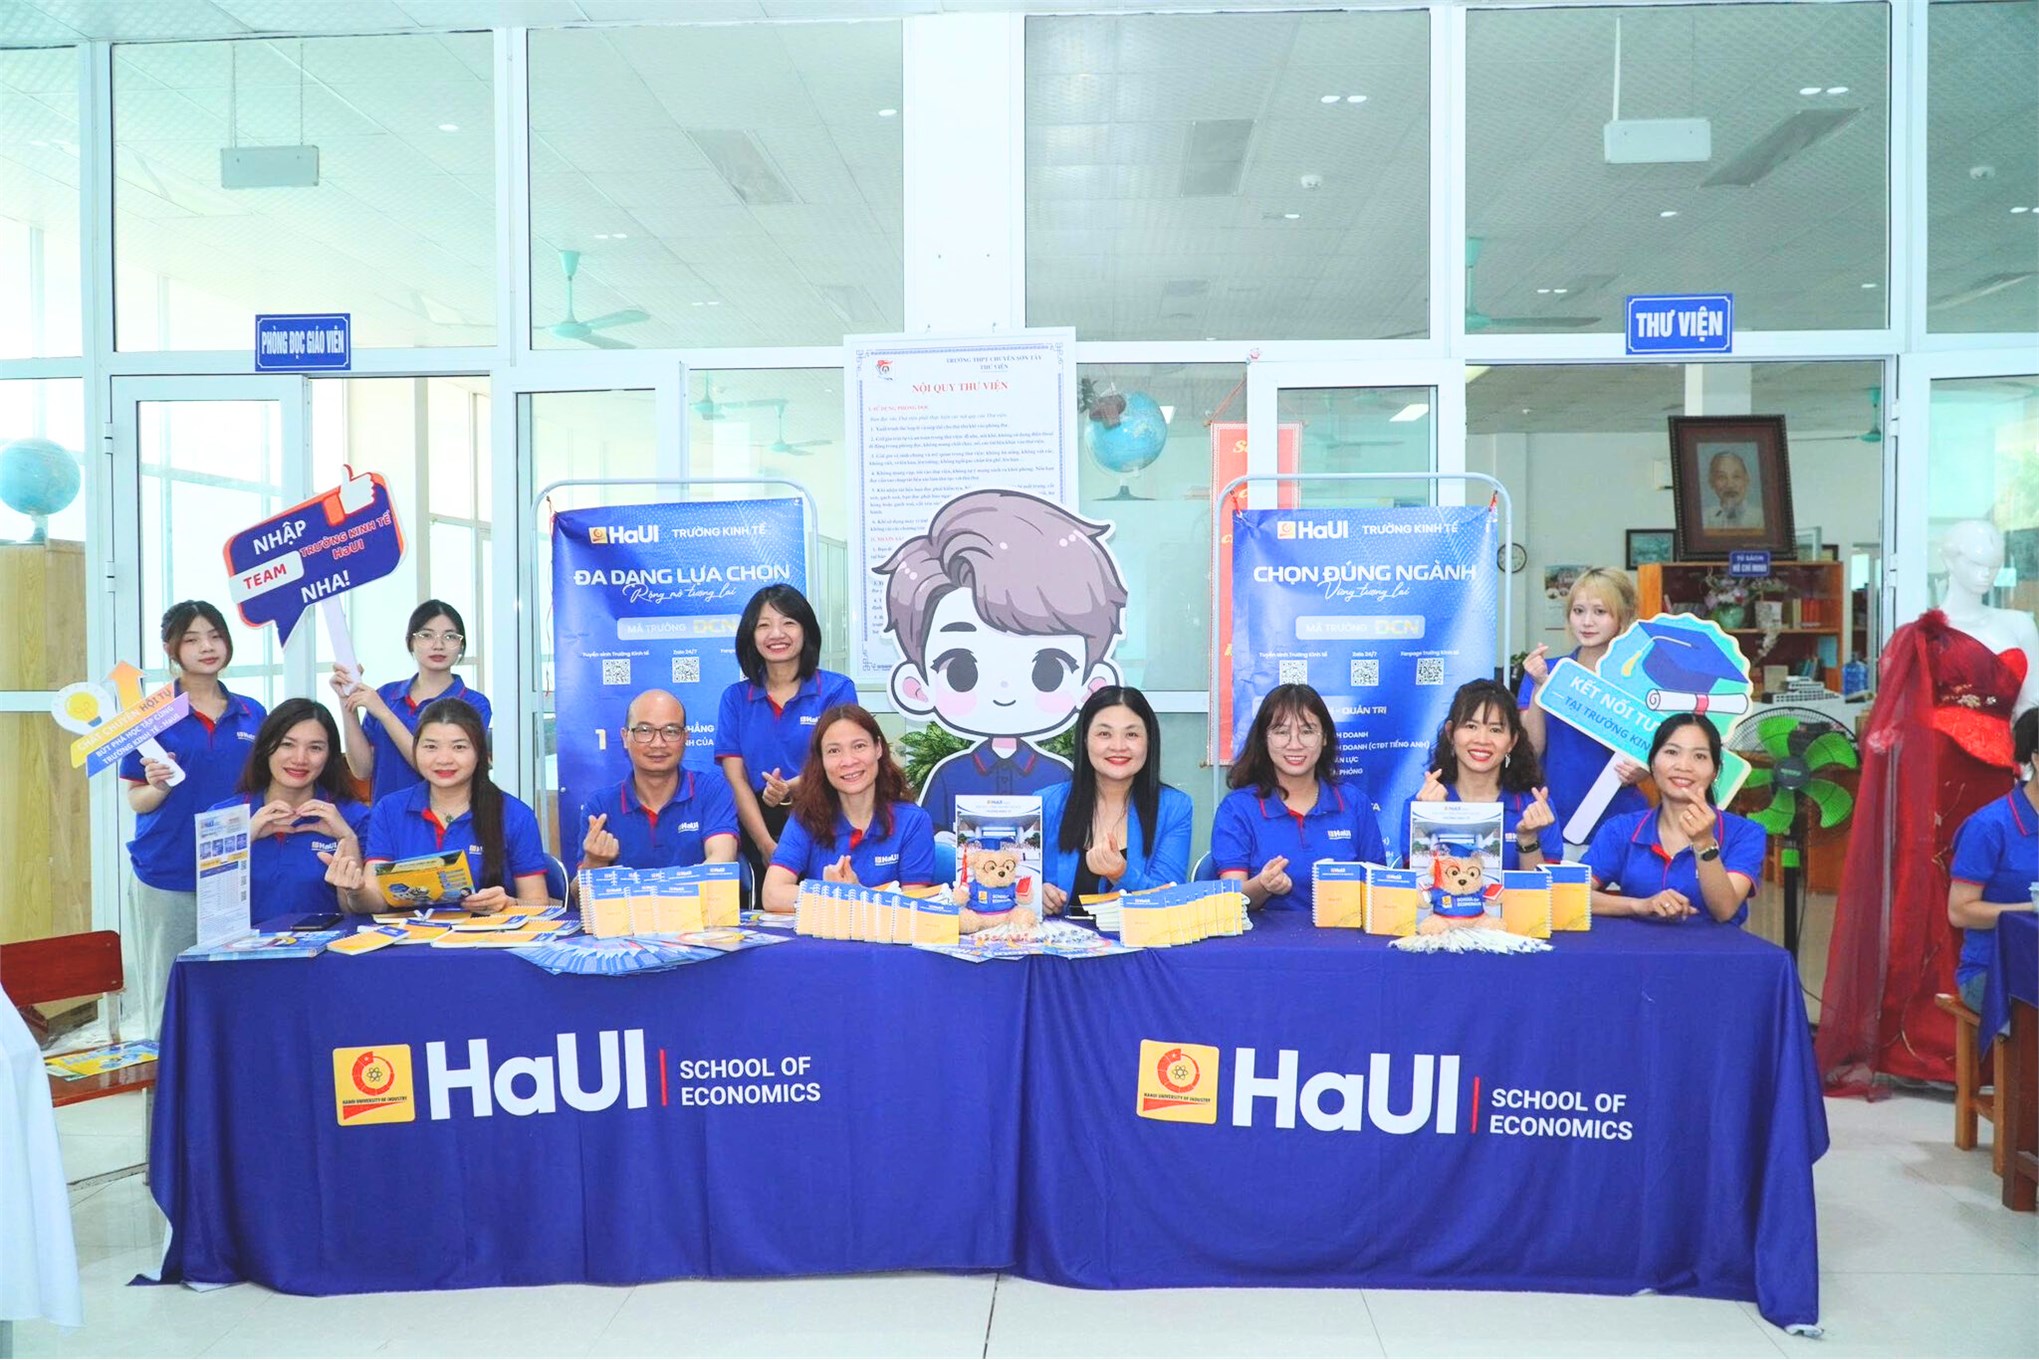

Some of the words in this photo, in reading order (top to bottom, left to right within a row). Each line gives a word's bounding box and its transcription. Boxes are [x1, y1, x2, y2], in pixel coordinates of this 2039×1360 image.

[1635, 309, 1676, 338] THƯ
[1677, 305, 1723, 342] VIỆN
[261, 325, 288, 354] PHÒNG
[289, 330, 305, 359] ĐỌC
[307, 325, 325, 354] GIÁO
[326, 325, 344, 354] VIÊN
[912, 382, 931, 394] NỘI
[933, 383, 955, 394] QUY
[960, 381, 981, 391] THƯ
[983, 379, 1008, 392] VIỆN
[253, 520, 307, 555] NHẬP
[300, 532, 348, 558] TRƯỜNG
[348, 519, 377, 538] KINH
[376, 509, 392, 528] TẾ
[609, 525, 660, 544] HaUI
[672, 526, 721, 538] TRƯỜNG
[722, 526, 750, 537] KINH
[751, 521, 767, 535] TẾ
[1298, 520, 1349, 539] HaUI
[1362, 521, 1412, 535] TRƯỜNG
[1413, 523, 1443, 534] KINH
[1443, 520, 1460, 533] TẾ
[331, 538, 366, 560] HaUI
[243, 563, 287, 590] TEAM
[574, 569, 607, 586] ĐA
[611, 567, 673, 588] DẠNG
[676, 564, 723, 585] LỰA
[726, 563, 791, 584] CHỌN
[1253, 565, 1319, 585] CHỌN
[1322, 561, 1392, 582] ĐÚNG
[1395, 559, 1477, 581] NGÀNH
[301, 570, 351, 603] NHA!
[718, 582, 737, 599] lai
[647, 622, 686, 633] TRƯỜNG
[693, 618, 737, 633] DCN
[1375, 619, 1419, 635] DCN
[140, 698, 160, 712] HỘI
[1569, 673, 1600, 699] KẾT
[1599, 692, 1633, 721] NỐI
[1342, 704, 1371, 716] QUẢN
[126, 728, 142, 740] HỌC
[1564, 695, 1582, 713] TẠI
[1583, 704, 1629, 739] TRƯỜNG
[1629, 733, 1651, 751] KIN
[132, 732, 151, 747] KINH
[696, 737, 714, 747] CỦA
[1389, 739, 1409, 749] TIẾNG
[1339, 767, 1363, 776] PHÒNG
[1345, 756, 1359, 764] LỰC
[425, 1028, 648, 1121] HaUI
[678, 1058, 777, 1081] SCHOOL
[780, 1056, 812, 1076] OF
[680, 1082, 822, 1107] ECONOMICS
[1231, 1046, 1461, 1136] HaUI
[1491, 1087, 1589, 1114] SCHOOL
[1594, 1092, 1627, 1114] OF
[1489, 1116, 1634, 1142] ECONOMICS
